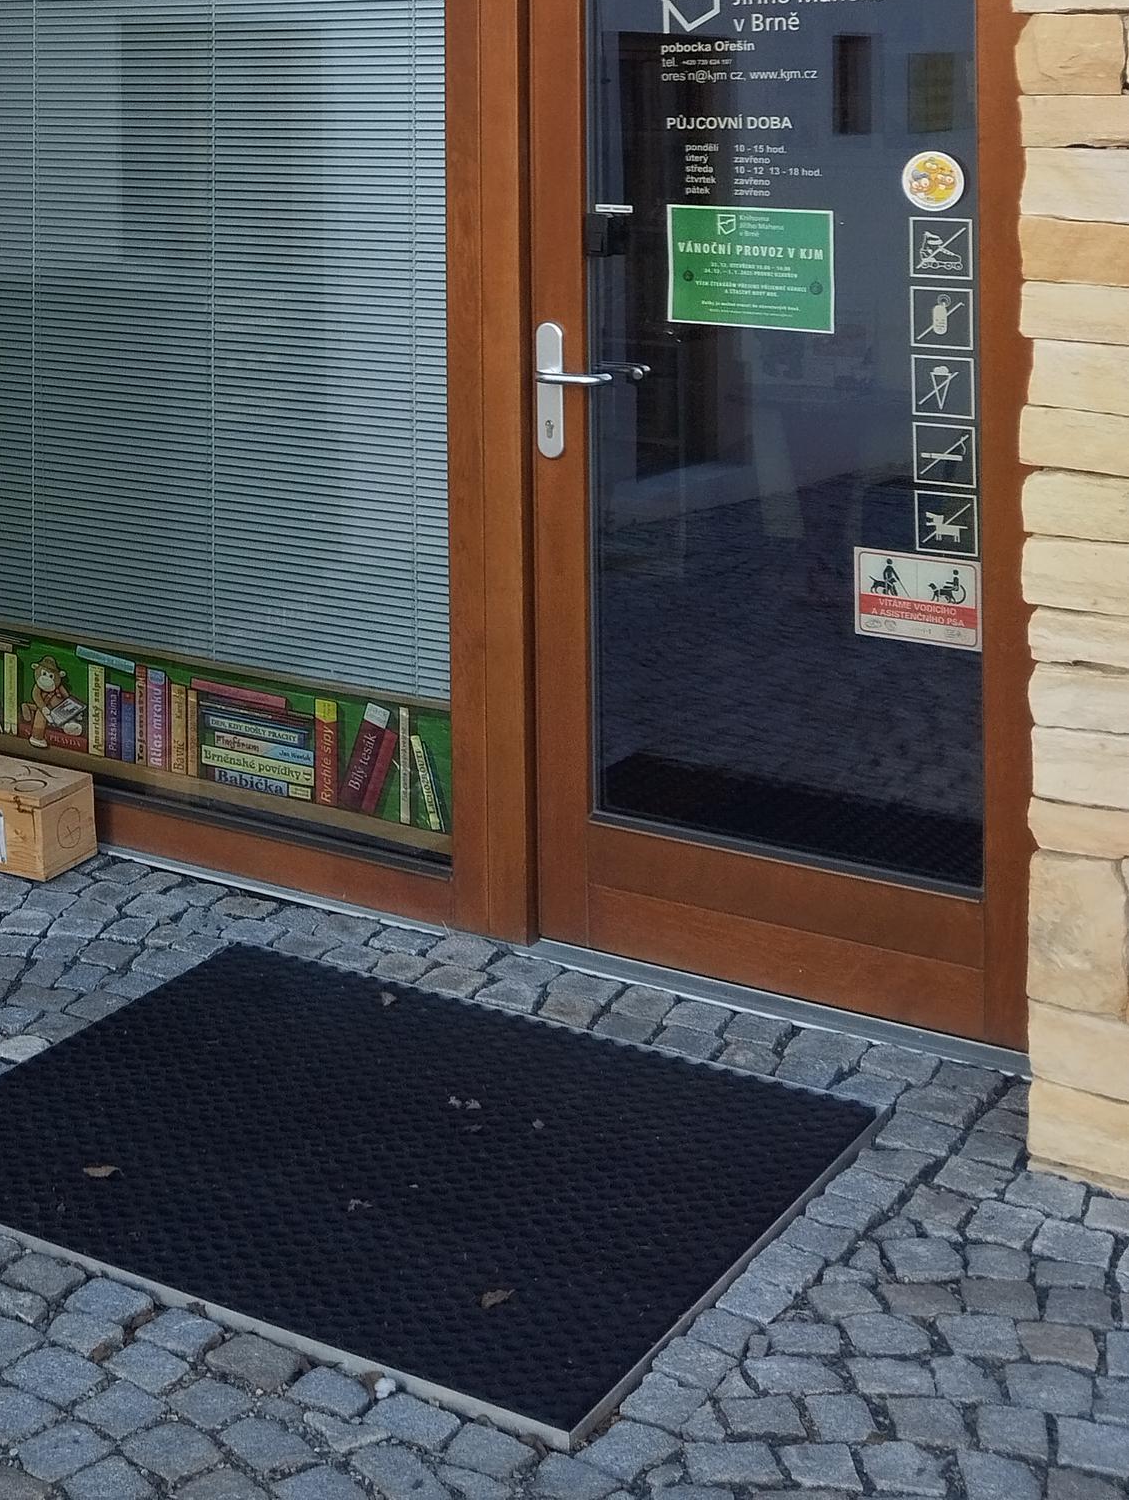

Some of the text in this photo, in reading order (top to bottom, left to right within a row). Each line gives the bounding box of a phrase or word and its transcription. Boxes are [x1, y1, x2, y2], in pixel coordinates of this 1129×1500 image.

[733, 12, 800, 32] v Brně
[714, 40, 756, 53] Ořešín
[661, 56, 679, 68] tel.
[749, 69, 818, 83] www.kjm.cz
[746, 116, 793, 130] DOBA
[685, 143, 719, 154] pondělí
[734, 144, 746, 153] 10
[754, 144, 765, 153] 15
[766, 144, 788, 154] hod.
[685, 153, 771, 165] úterý zavřeno
[685, 164, 714, 174] středa
[734, 166, 746, 175] 10
[753, 167, 765, 175] 12
[770, 167, 781, 176] 13
[789, 167, 800, 176] 18
[801, 168, 823, 177] hod.
[685, 174, 771, 187] čtvrtek zavřeno
[685, 185, 771, 198] pátek zavřeno
[677, 240, 825, 260] VÁNOČNÍ PROVOZ V KJM
[878, 596, 912, 611] VÍTÁME
[871, 607, 966, 628] A ASISTENČNÍHO PSA
[92, 672, 102, 751] Americký sniper
[109, 694, 119, 715] zima
[228, 721, 243, 731] KDY
[150, 733, 163, 767] Atlas
[173, 739, 185, 771] Bavič
[359, 733, 377, 766] tesák
[203, 749, 302, 780] Brněnské povídky
[217, 770, 285, 797] Babička
[320, 756, 334, 803] Rychlé
